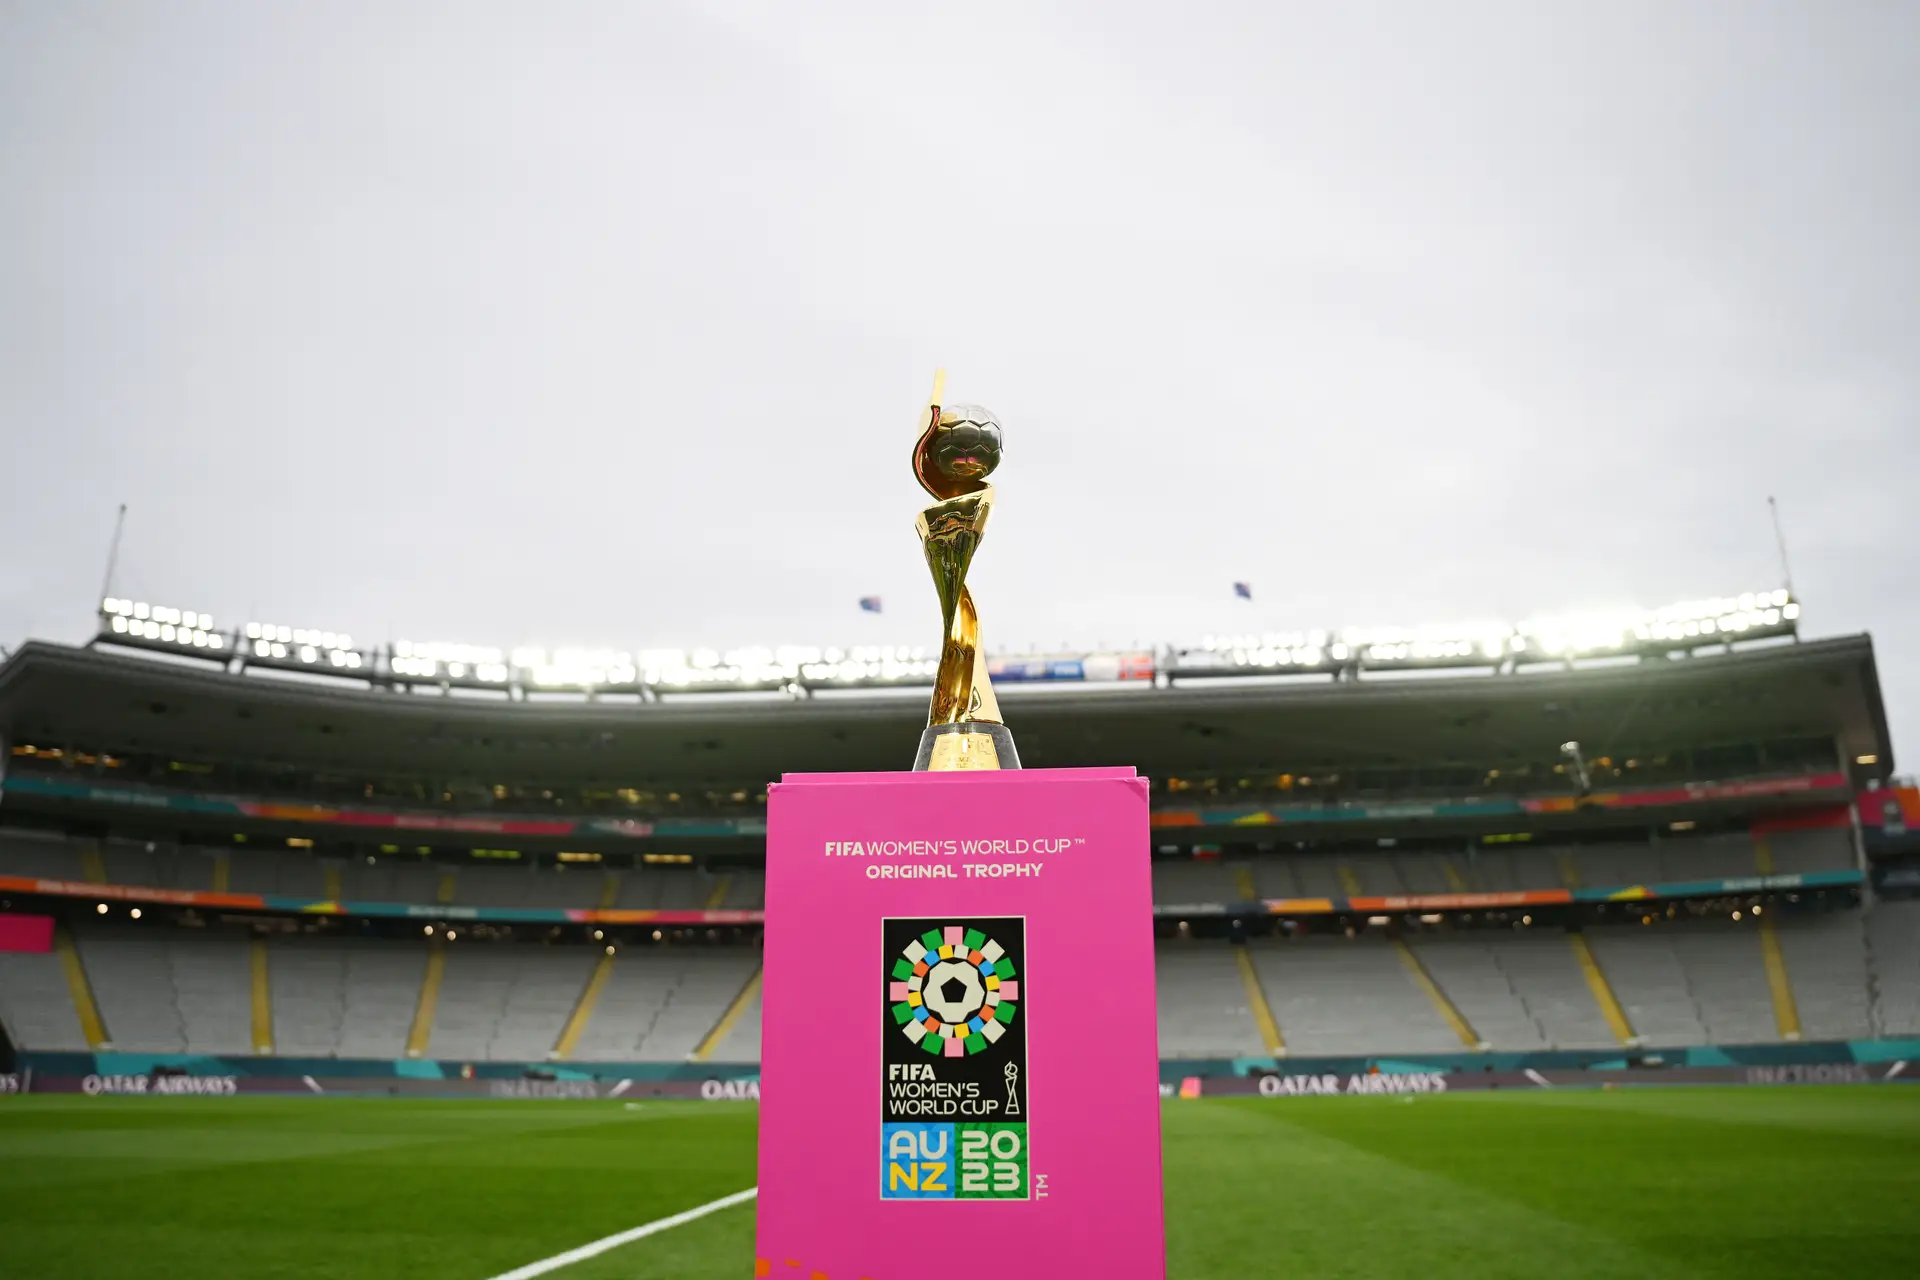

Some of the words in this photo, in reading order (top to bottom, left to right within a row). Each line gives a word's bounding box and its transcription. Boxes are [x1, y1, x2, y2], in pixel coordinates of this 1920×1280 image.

[825, 841, 865, 856] FIFA
[866, 840, 957, 856] WOMEN'S
[961, 839, 1029, 854] WORLD
[865, 864, 958, 879] ORIGINAL
[962, 863, 1043, 878] TROPHY
[889, 1064, 936, 1081] FIFA
[82, 1073, 149, 1096] QATAR
[889, 1082, 980, 1098] WOMEN'S
[1258, 1074, 1341, 1098] QATAR
[1346, 1071, 1448, 1095] AIRWAYS
[889, 1100, 958, 1115] WORLD
[960, 1100, 999, 1115] CUP
[889, 1130, 948, 1160] AU
[962, 1130, 1021, 1160] 20
[889, 1162, 948, 1191] NZ
[962, 1162, 1021, 1191] 23
